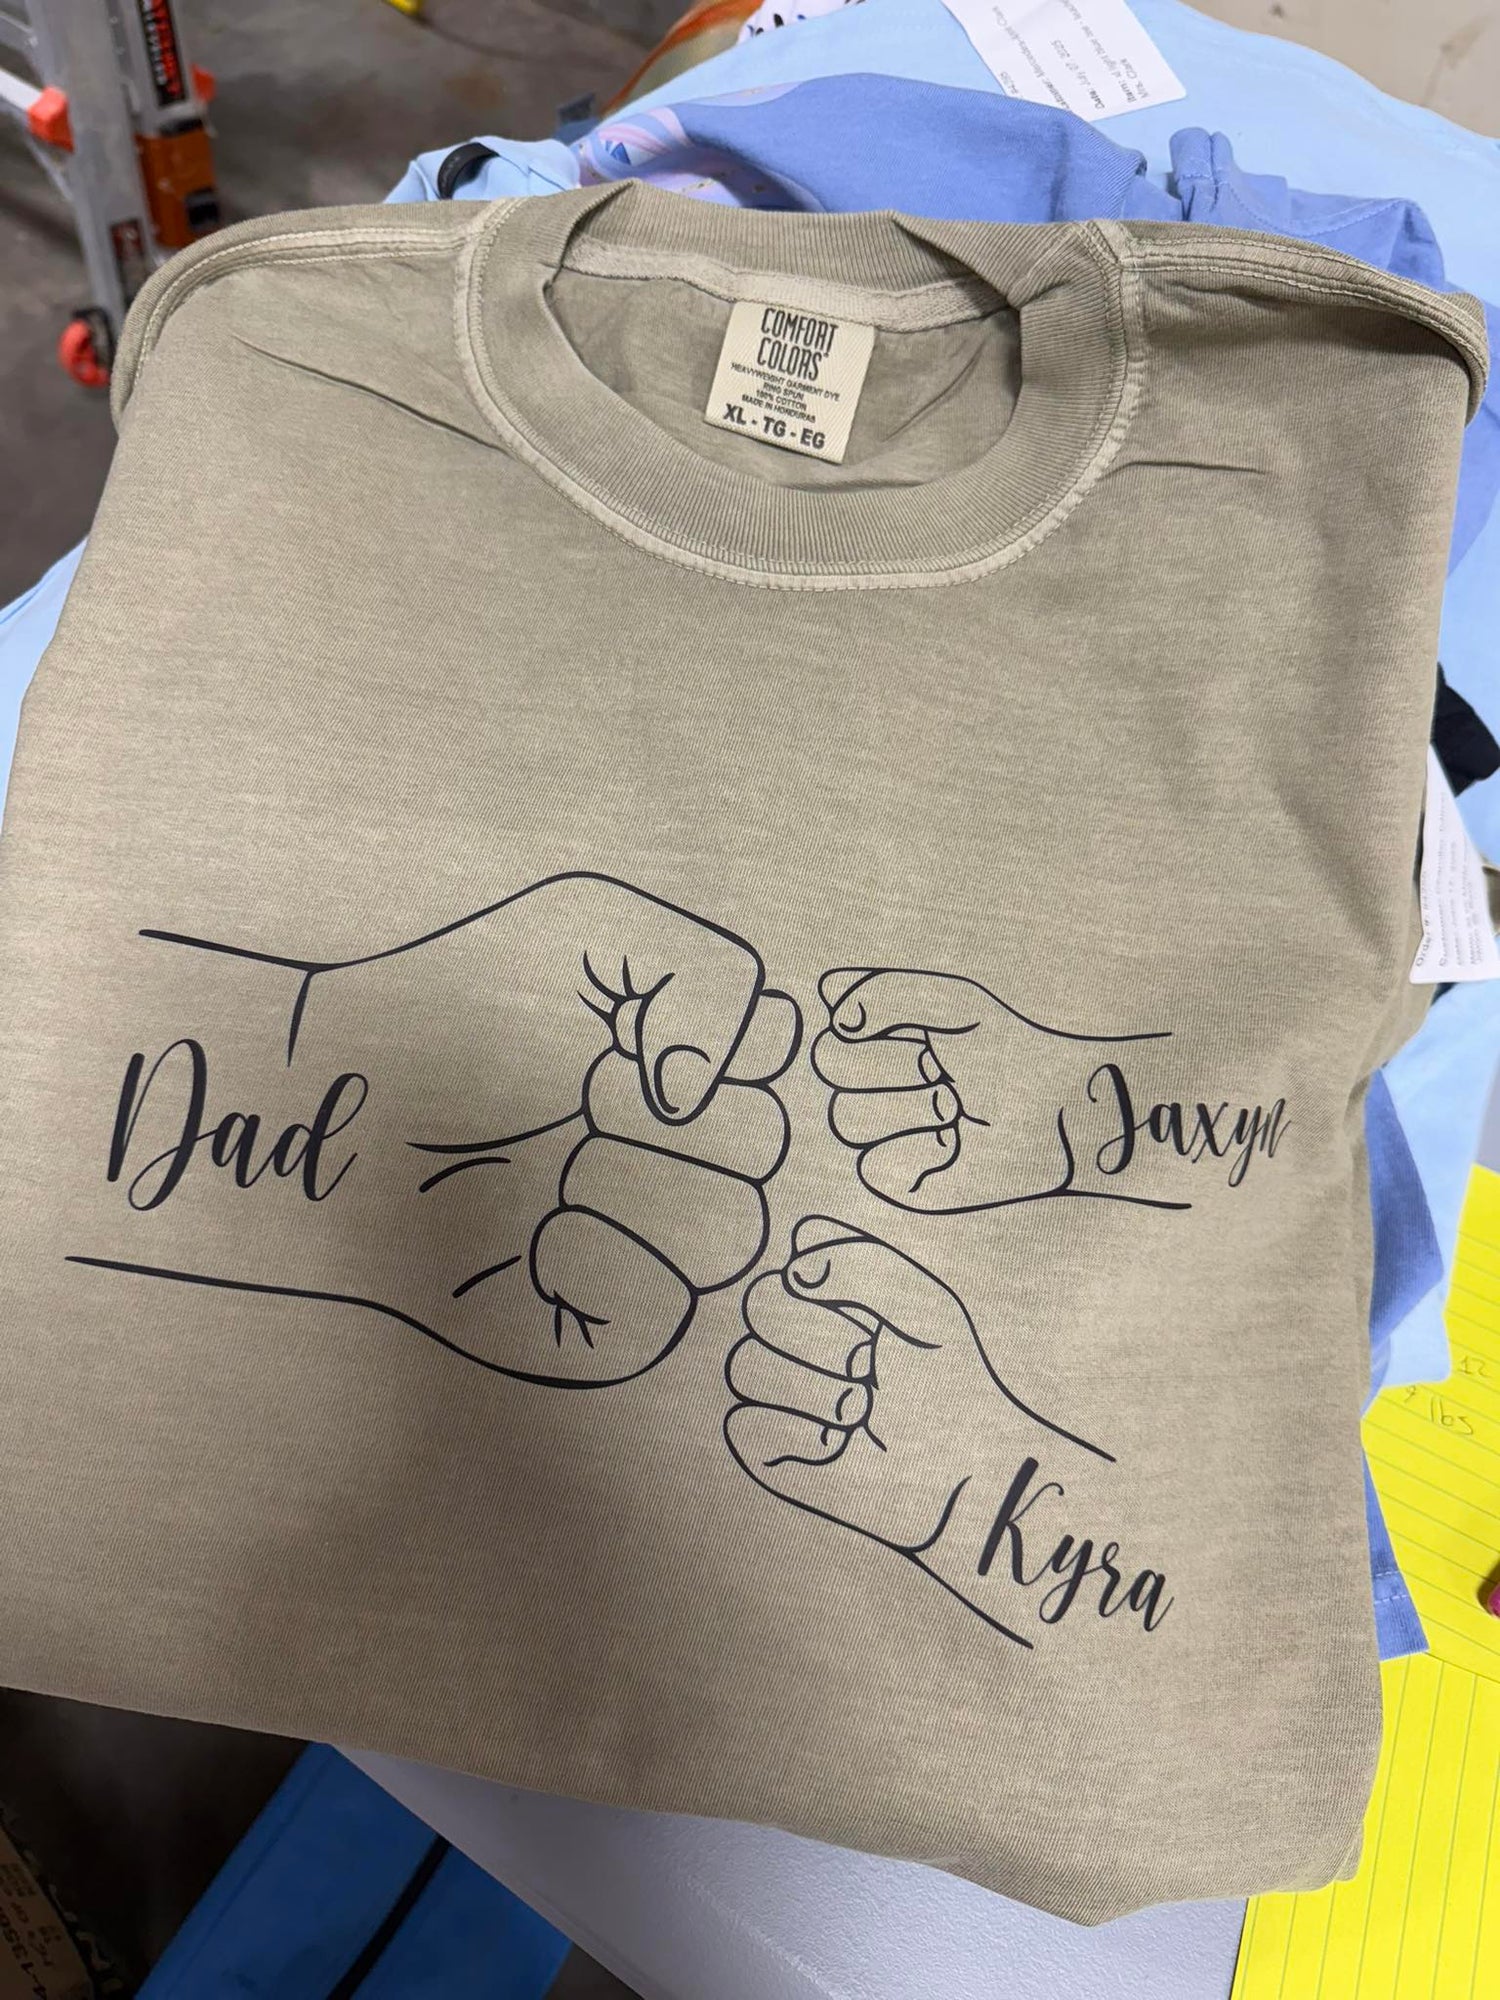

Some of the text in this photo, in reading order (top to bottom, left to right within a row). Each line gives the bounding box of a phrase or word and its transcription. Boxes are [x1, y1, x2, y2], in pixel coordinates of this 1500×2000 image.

[761, 307, 839, 352] COMFORT
[757, 337, 823, 381] COLORS
[731, 362, 840, 402] HEAVYWEIGHT GARMENT DYE
[756, 390, 808, 411] 100% COTTON
[763, 382, 805, 401] RING SPUN
[722, 403, 747, 426] XL
[763, 416, 786, 438] TG
[800, 428, 826, 449] EG
[742, 394, 816, 423] MADE IN HONDURAS
[107, 1038, 369, 1212] Dad
[1087, 1063, 1292, 1187] Jaxyn
[1430, 1396, 1474, 1435] lbs
[977, 1456, 1175, 1632] Kyra
